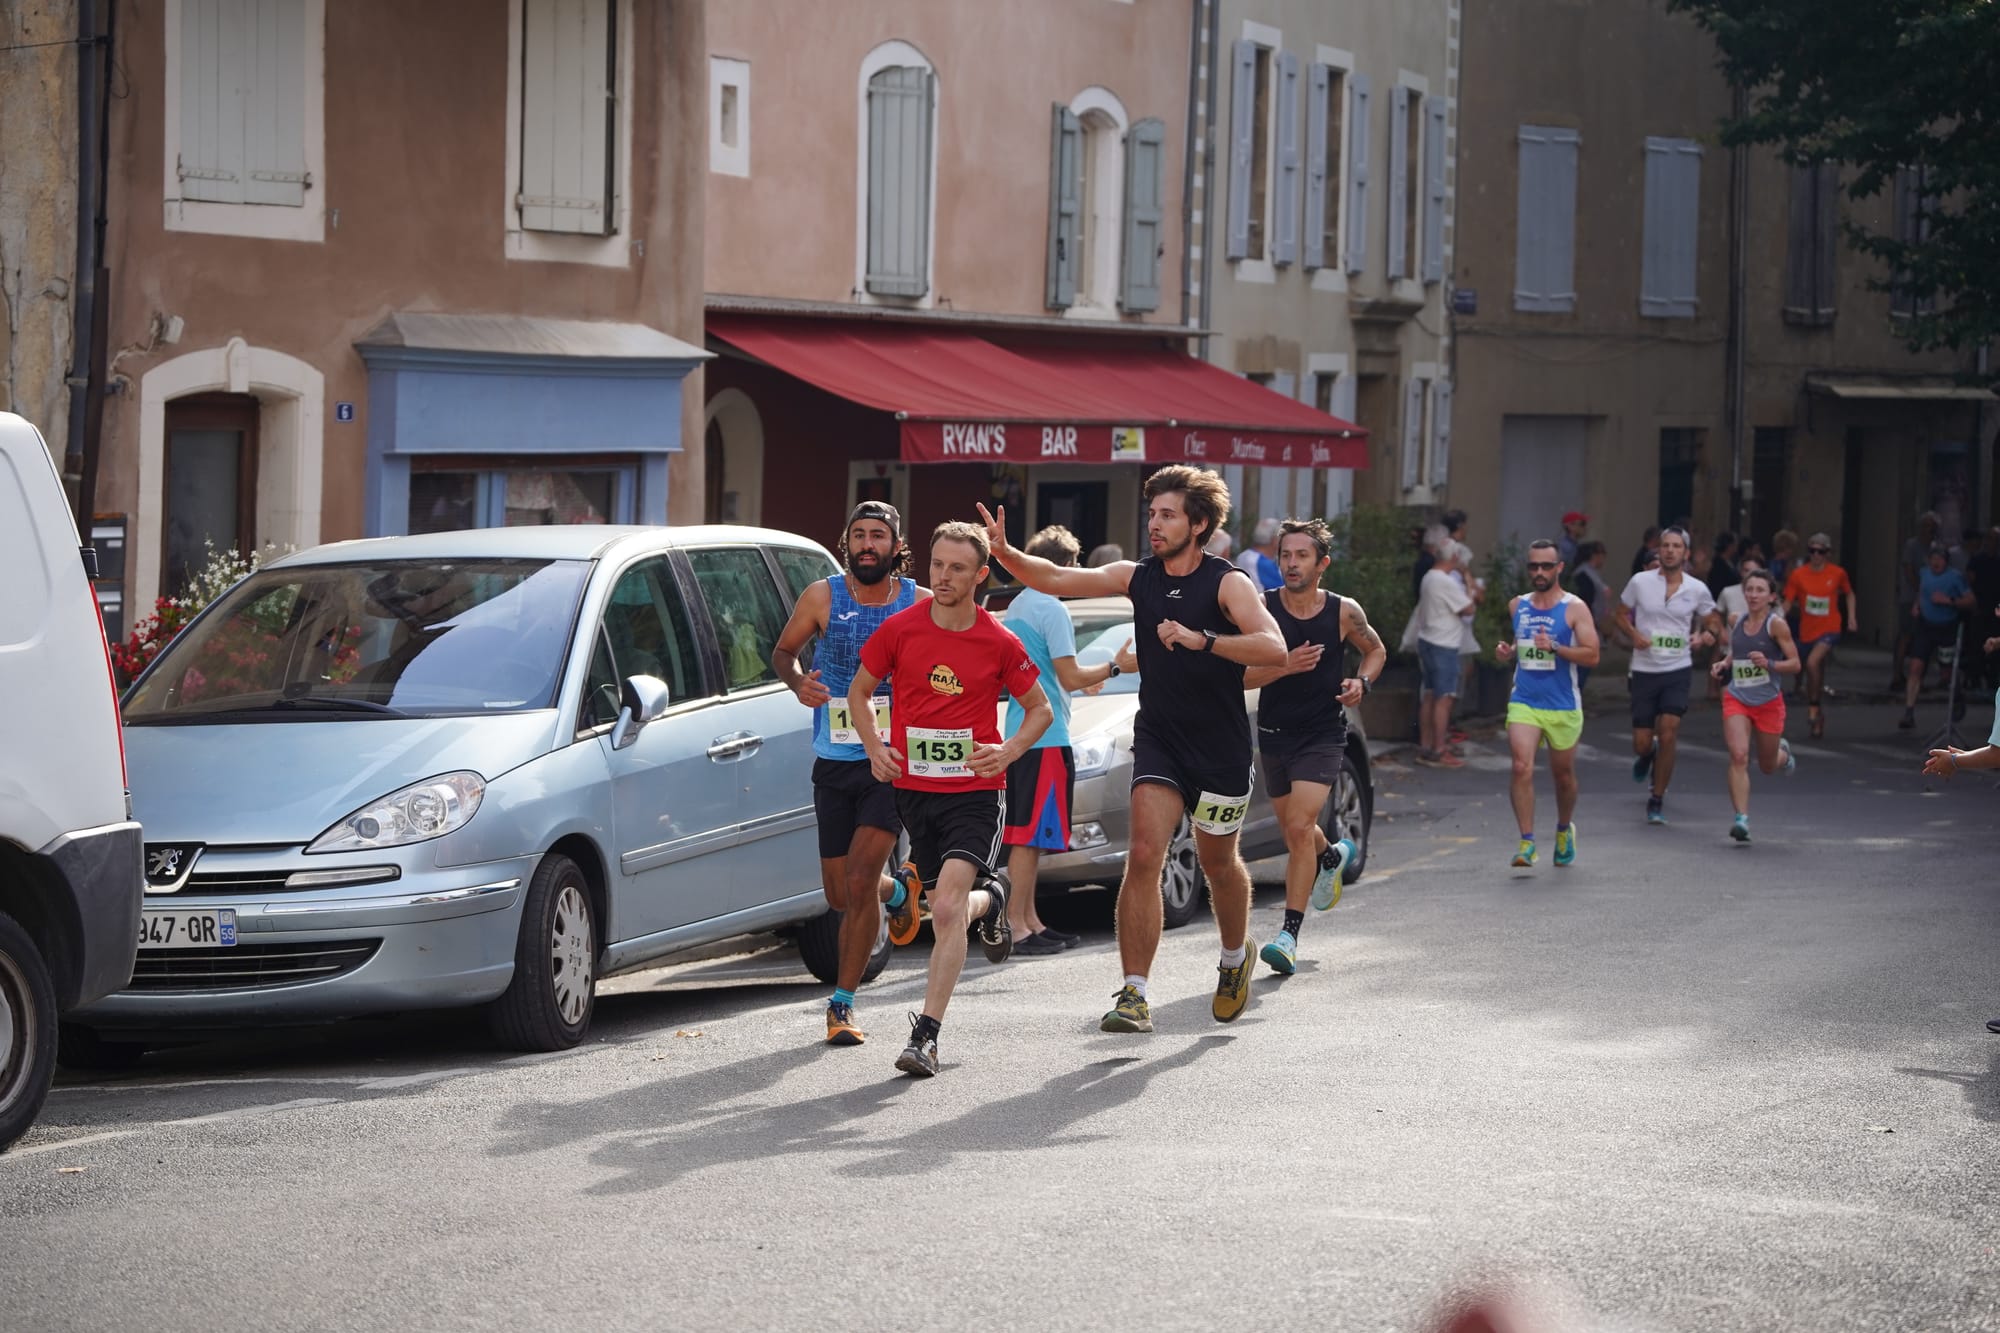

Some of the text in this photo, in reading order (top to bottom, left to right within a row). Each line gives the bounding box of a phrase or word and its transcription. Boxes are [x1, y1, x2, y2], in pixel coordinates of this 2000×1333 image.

[341, 405, 350, 419] 6
[942, 423, 1007, 456] RYAN'S
[1041, 426, 1078, 456] BAR
[1184, 431, 1207, 457] Chez
[1230, 436, 1266, 461] Martine
[1282, 443, 1292, 462] et
[1657, 636, 1681, 648] 105
[1525, 648, 1545, 660] 46
[1737, 665, 1764, 679] 192
[916, 741, 964, 762] 153
[1206, 803, 1246, 823] 185
[221, 928, 235, 940] 59
